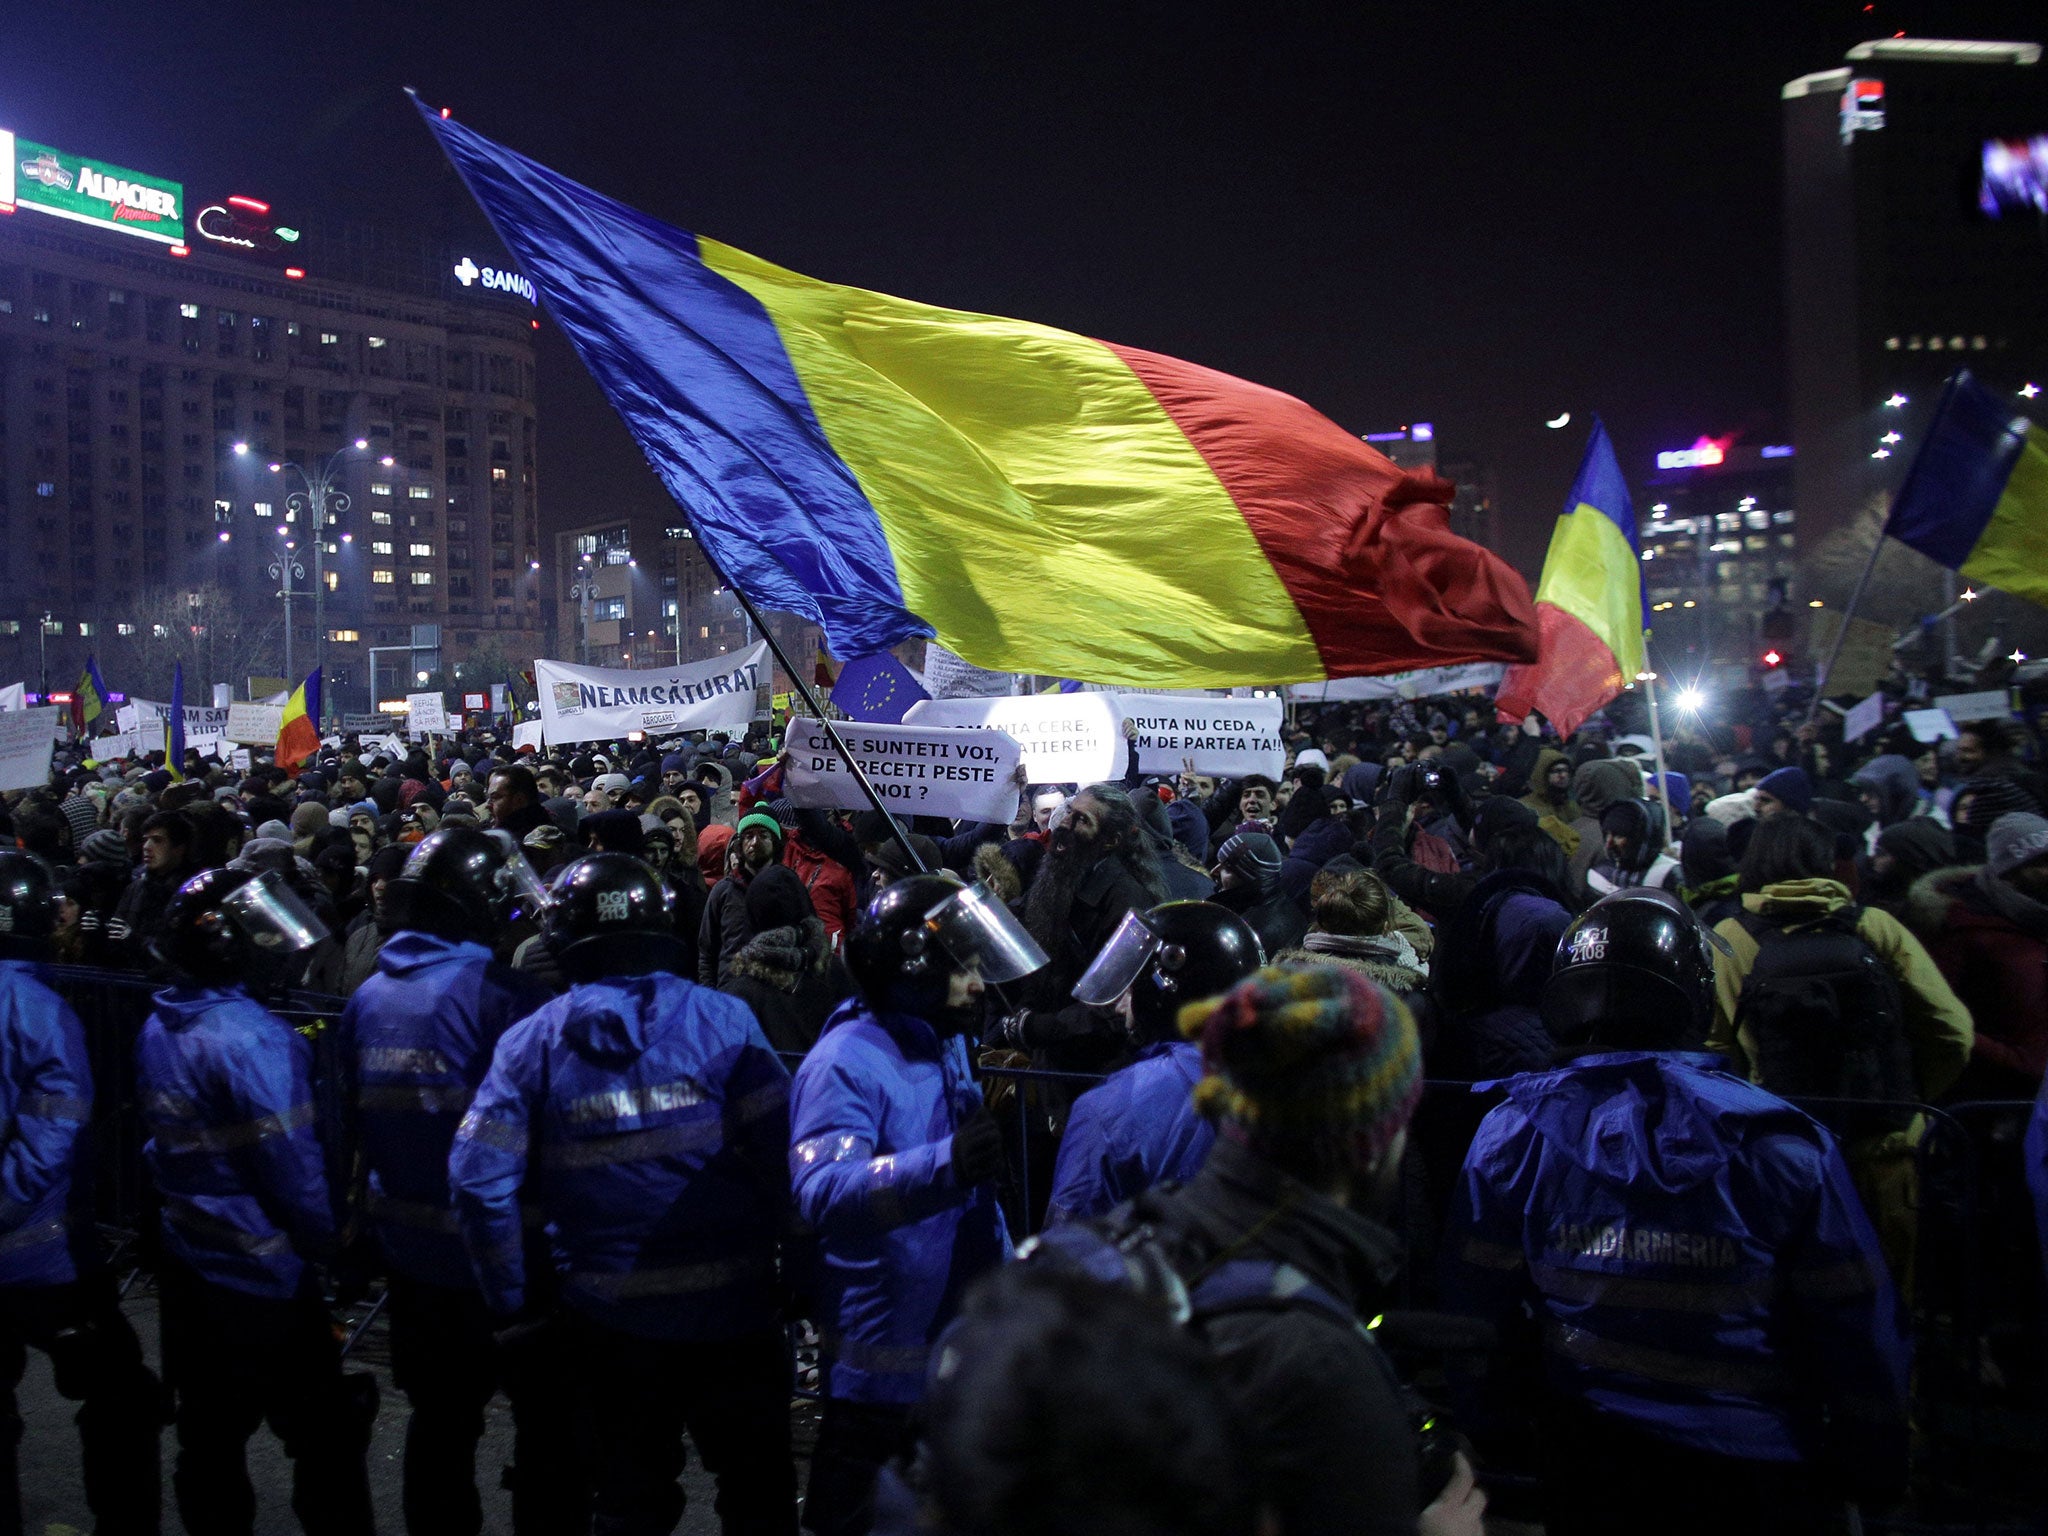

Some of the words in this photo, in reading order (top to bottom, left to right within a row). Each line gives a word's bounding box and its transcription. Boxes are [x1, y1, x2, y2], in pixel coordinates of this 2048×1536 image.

[77, 167, 179, 221] ALBACHER
[579, 663, 758, 709] NEAMSĂTURAT
[1038, 719, 1090, 733] CERE,
[1184, 719, 1207, 731] NU
[1212, 719, 1256, 732] CEDA
[862, 739, 952, 759] SUNTETI
[956, 745, 1000, 765] VOI,
[1019, 739, 1097, 754] ATIERE!!
[1157, 737, 1179, 749] DE
[1184, 737, 1246, 750] PARTEA
[1252, 739, 1282, 752] TA!!
[811, 757, 837, 773] DE
[933, 765, 995, 783] PESTE
[873, 783, 911, 800] NOI
[1570, 945, 1605, 963] 2108
[1556, 1222, 1738, 1269] JANDARMERIA
